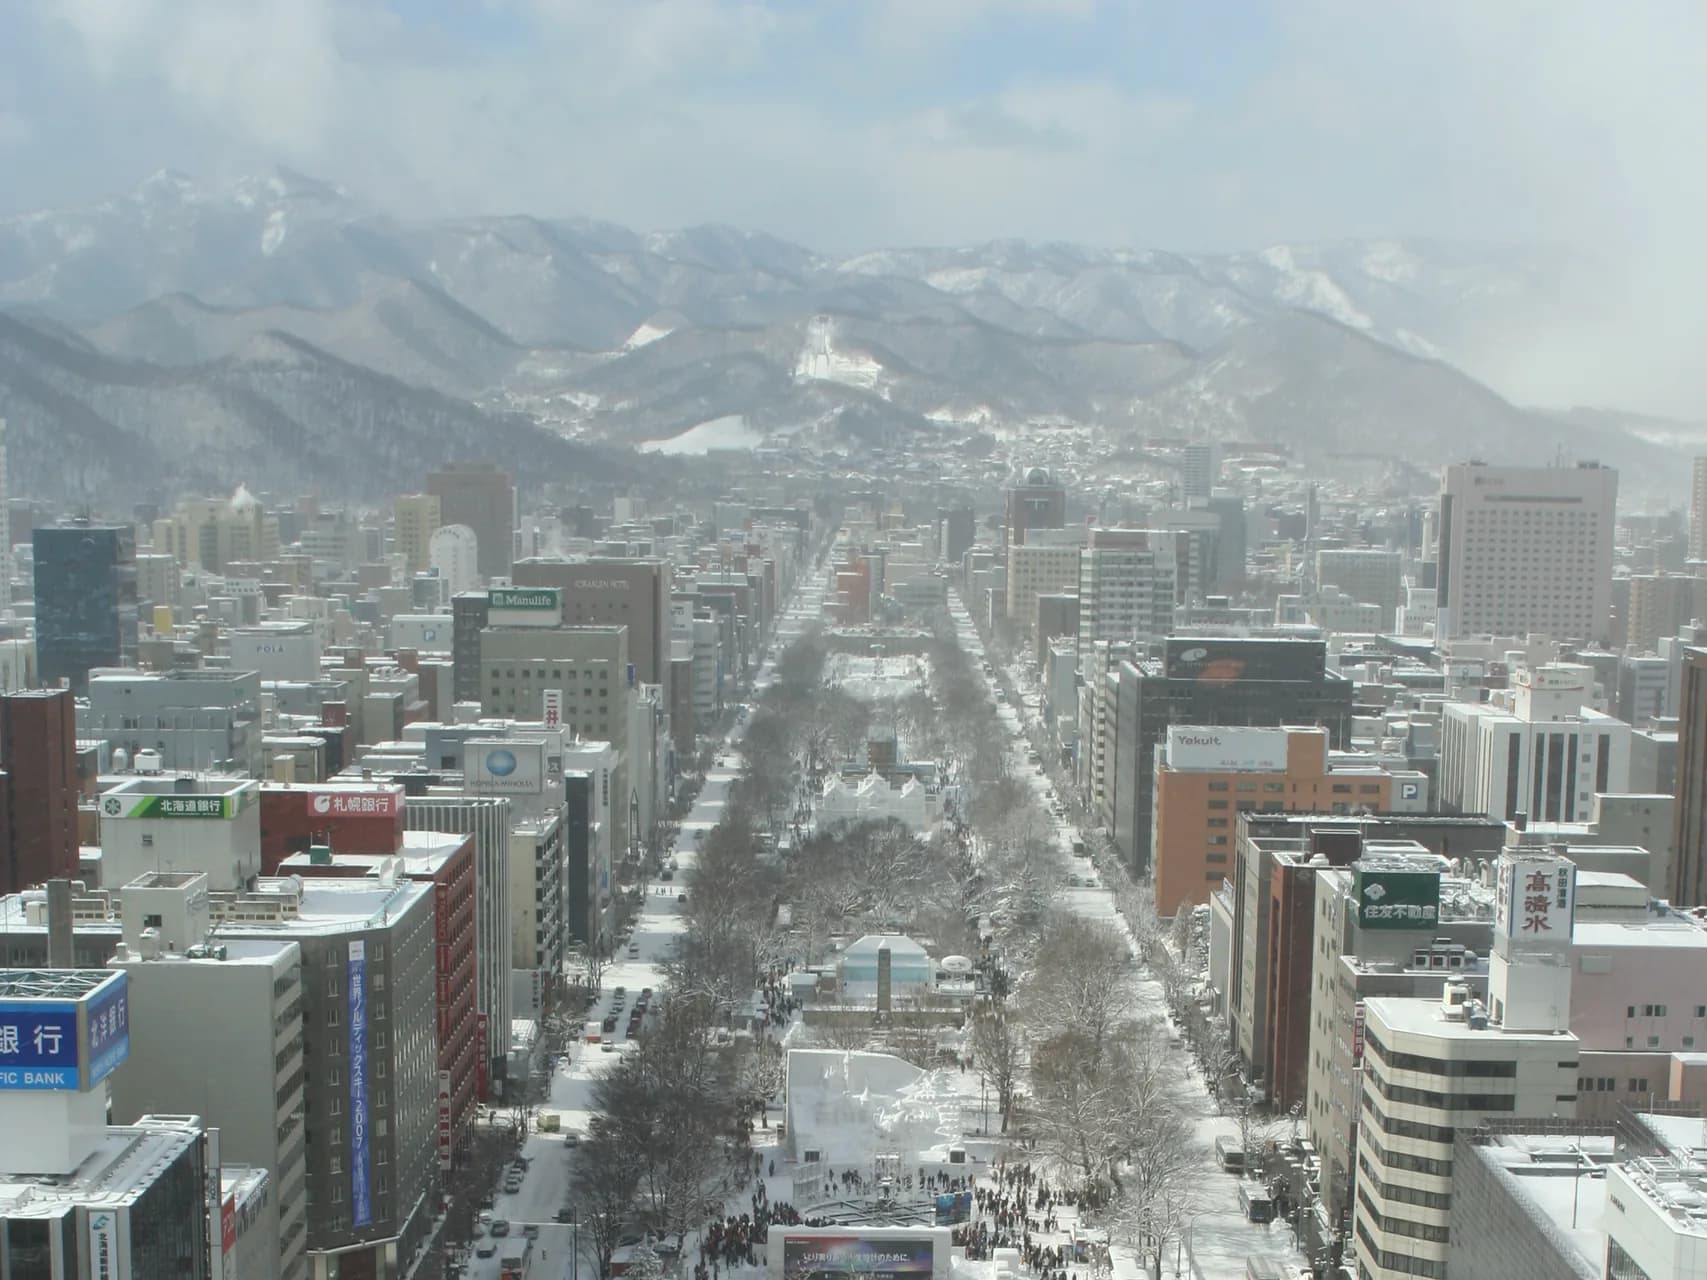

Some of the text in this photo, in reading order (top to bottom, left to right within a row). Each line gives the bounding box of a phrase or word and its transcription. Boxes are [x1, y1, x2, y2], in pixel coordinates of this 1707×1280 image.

[505, 594, 552, 607] Manulife
[256, 645, 284, 653] POLA
[546, 694, 559, 729] 三井
[1178, 735, 1222, 746] Yakult
[1403, 784, 1416, 798] P
[160, 799, 221, 812] 北海道銀行
[334, 797, 389, 812] 札幌銀行
[1363, 904, 1436, 920] 住友不動産
[91, 998, 125, 1049] 北洋銀行
[0, 1024, 62, 1055] 銀行
[24, 1073, 65, 1084] BANK
